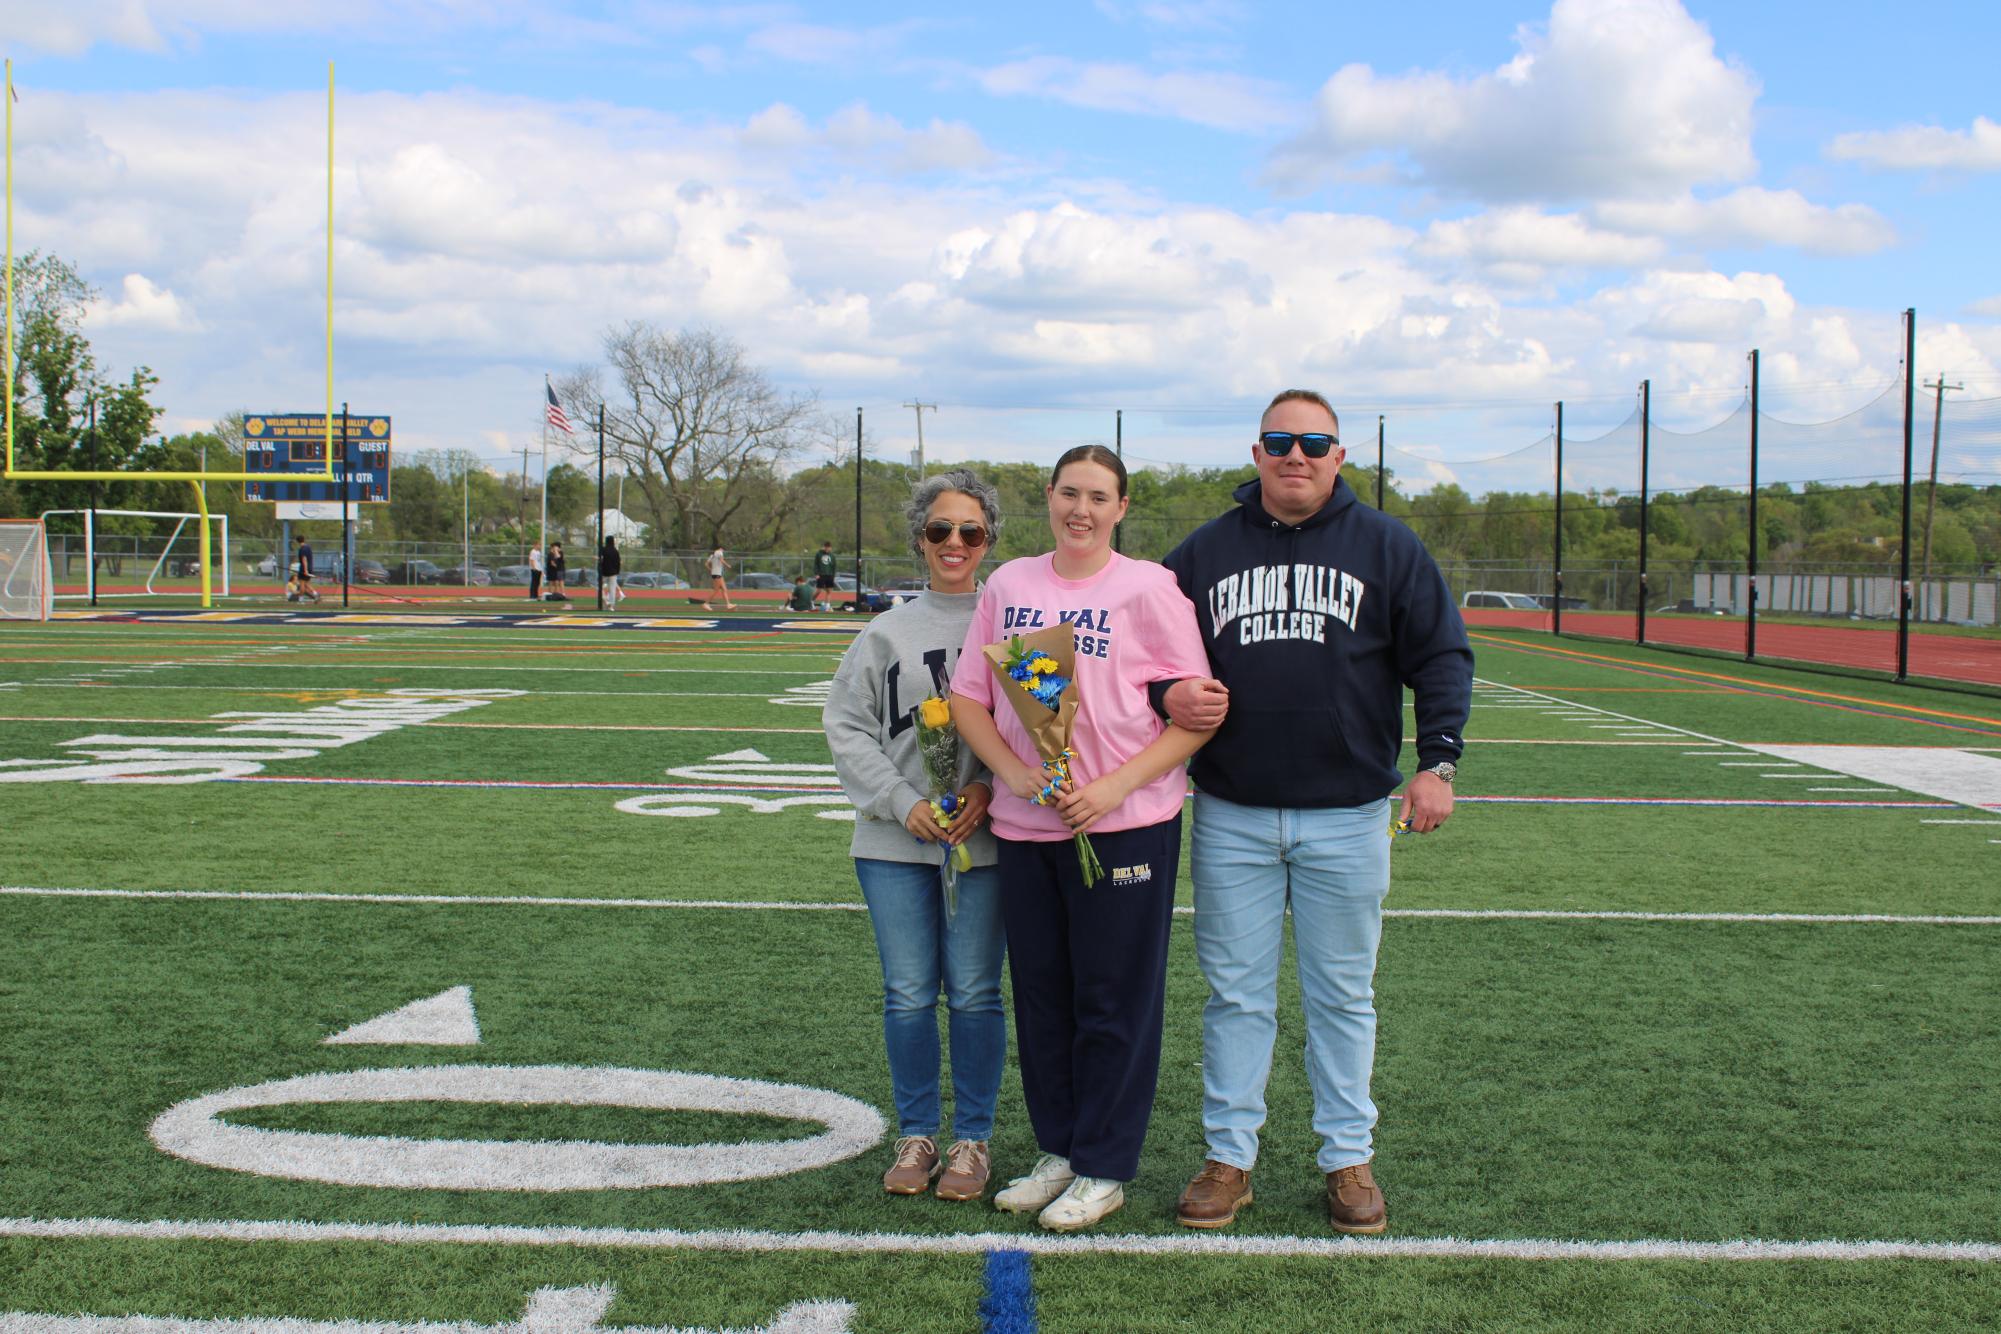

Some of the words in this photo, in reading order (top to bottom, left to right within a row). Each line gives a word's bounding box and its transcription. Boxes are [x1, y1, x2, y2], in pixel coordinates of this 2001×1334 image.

[309, 418, 343, 427] DELAARE
[246, 441, 260, 451] DEL
[261, 441, 276, 451] VAL
[358, 442, 388, 452] GUEST
[356, 473, 374, 483] QTR
[1208, 565, 1291, 640] LEBANON
[1294, 563, 1365, 633] VALLEY
[1003, 606, 1045, 630] DEL
[1059, 608, 1112, 635] VAL
[1239, 611, 1326, 646] COLLEGE
[1112, 866, 1133, 880] DEL
